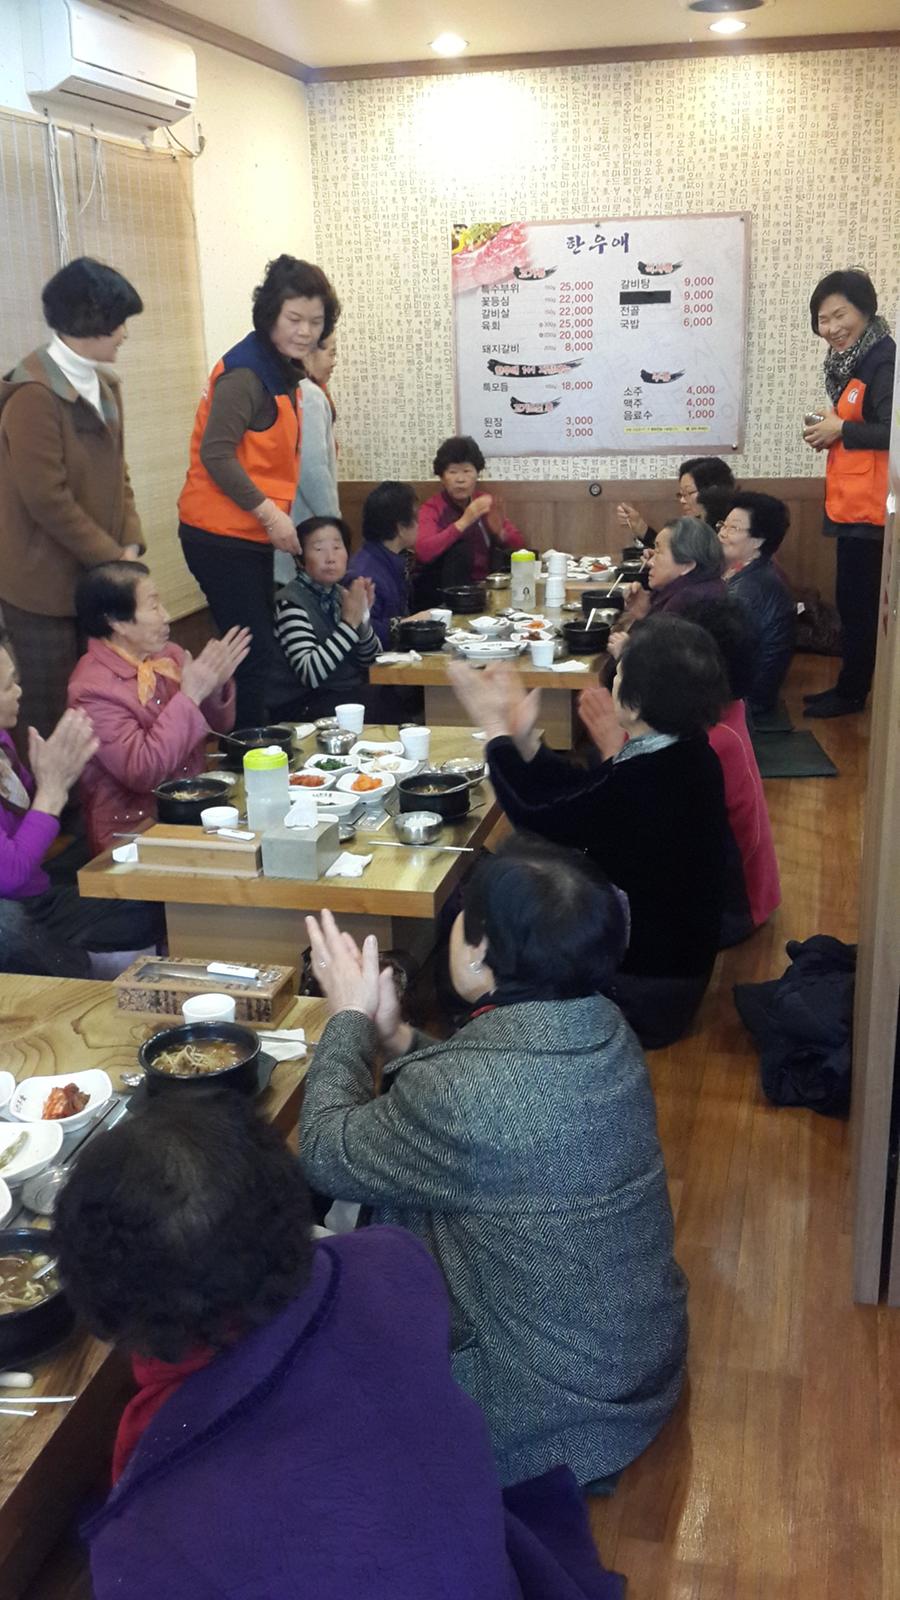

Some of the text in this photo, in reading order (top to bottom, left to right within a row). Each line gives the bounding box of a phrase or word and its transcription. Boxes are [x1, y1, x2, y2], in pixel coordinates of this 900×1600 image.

[481, 284, 519, 294] 특수부위
[560, 281, 593, 291] 25,000
[621, 277, 714, 290] 갈비탕 9,000
[481, 296, 510, 306] 꽃등심
[559, 294, 593, 304] 22,000
[684, 290, 713, 301] 9,000
[481, 309, 510, 318] 갈비살
[559, 306, 593, 316] 22,000
[620, 304, 713, 316] 전골 8,000
[481, 321, 500, 331] 육회
[559, 319, 593, 329] 25,000
[620, 317, 713, 329] 국밥 6,000
[560, 331, 593, 340] 20,000
[482, 344, 519, 354] 돼지갈비
[565, 342, 593, 352] 8,000
[562, 382, 593, 390] 18,000
[624, 386, 715, 396] 소주 4,000
[624, 398, 715, 408] 맥주 4,000
[624, 410, 715, 421] 음료수 1,000
[484, 416, 593, 427] 된장 3,000
[484, 428, 593, 438] 소면 3,000
